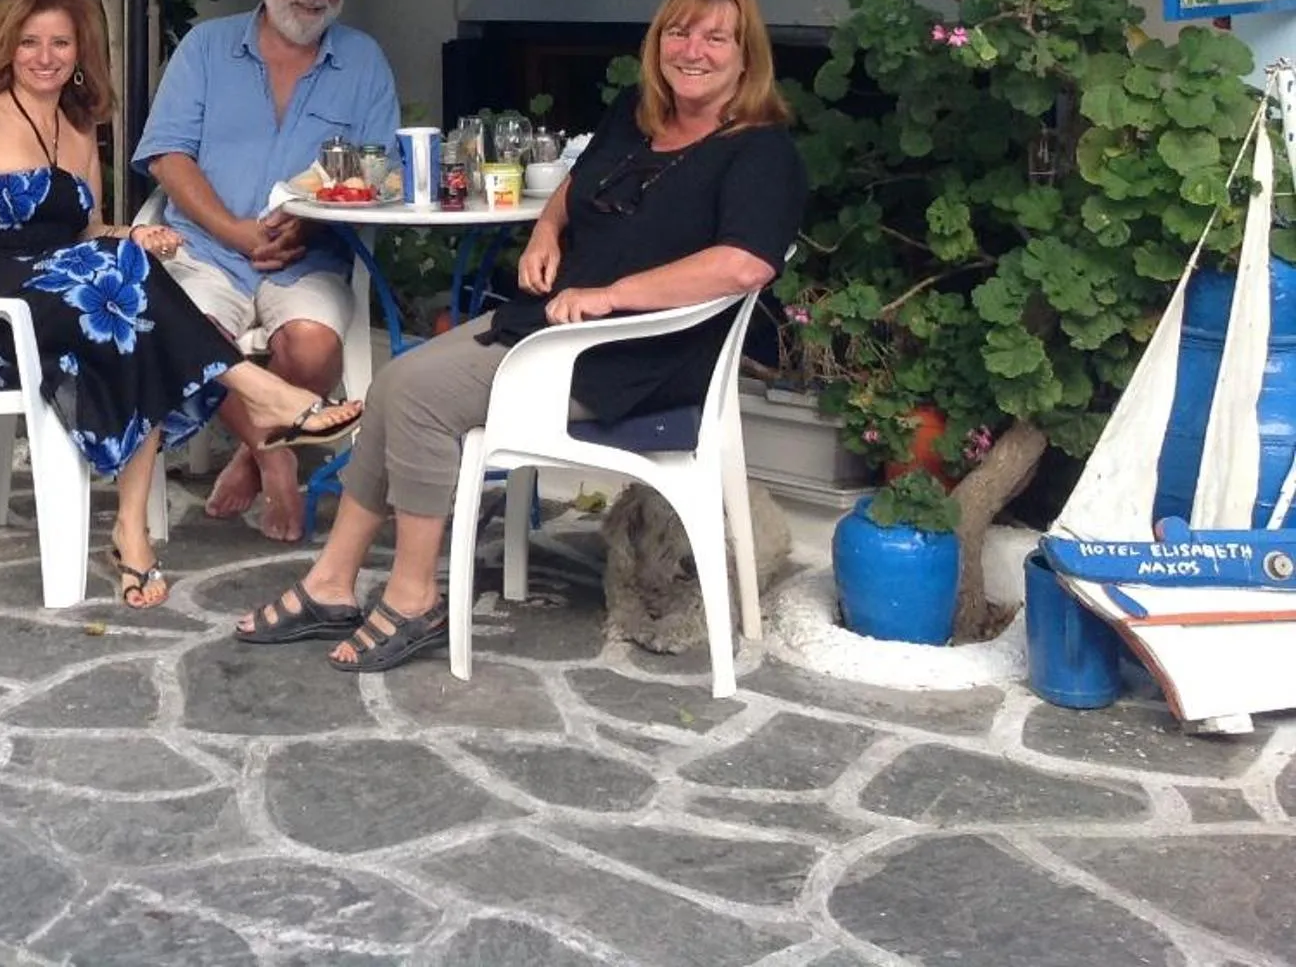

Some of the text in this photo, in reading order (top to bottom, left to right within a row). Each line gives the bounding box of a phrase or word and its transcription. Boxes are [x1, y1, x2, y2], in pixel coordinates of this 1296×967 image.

[1080, 542, 1253, 559] HOTEL ELISABETH
[1138, 561, 1201, 576] NAXOS
